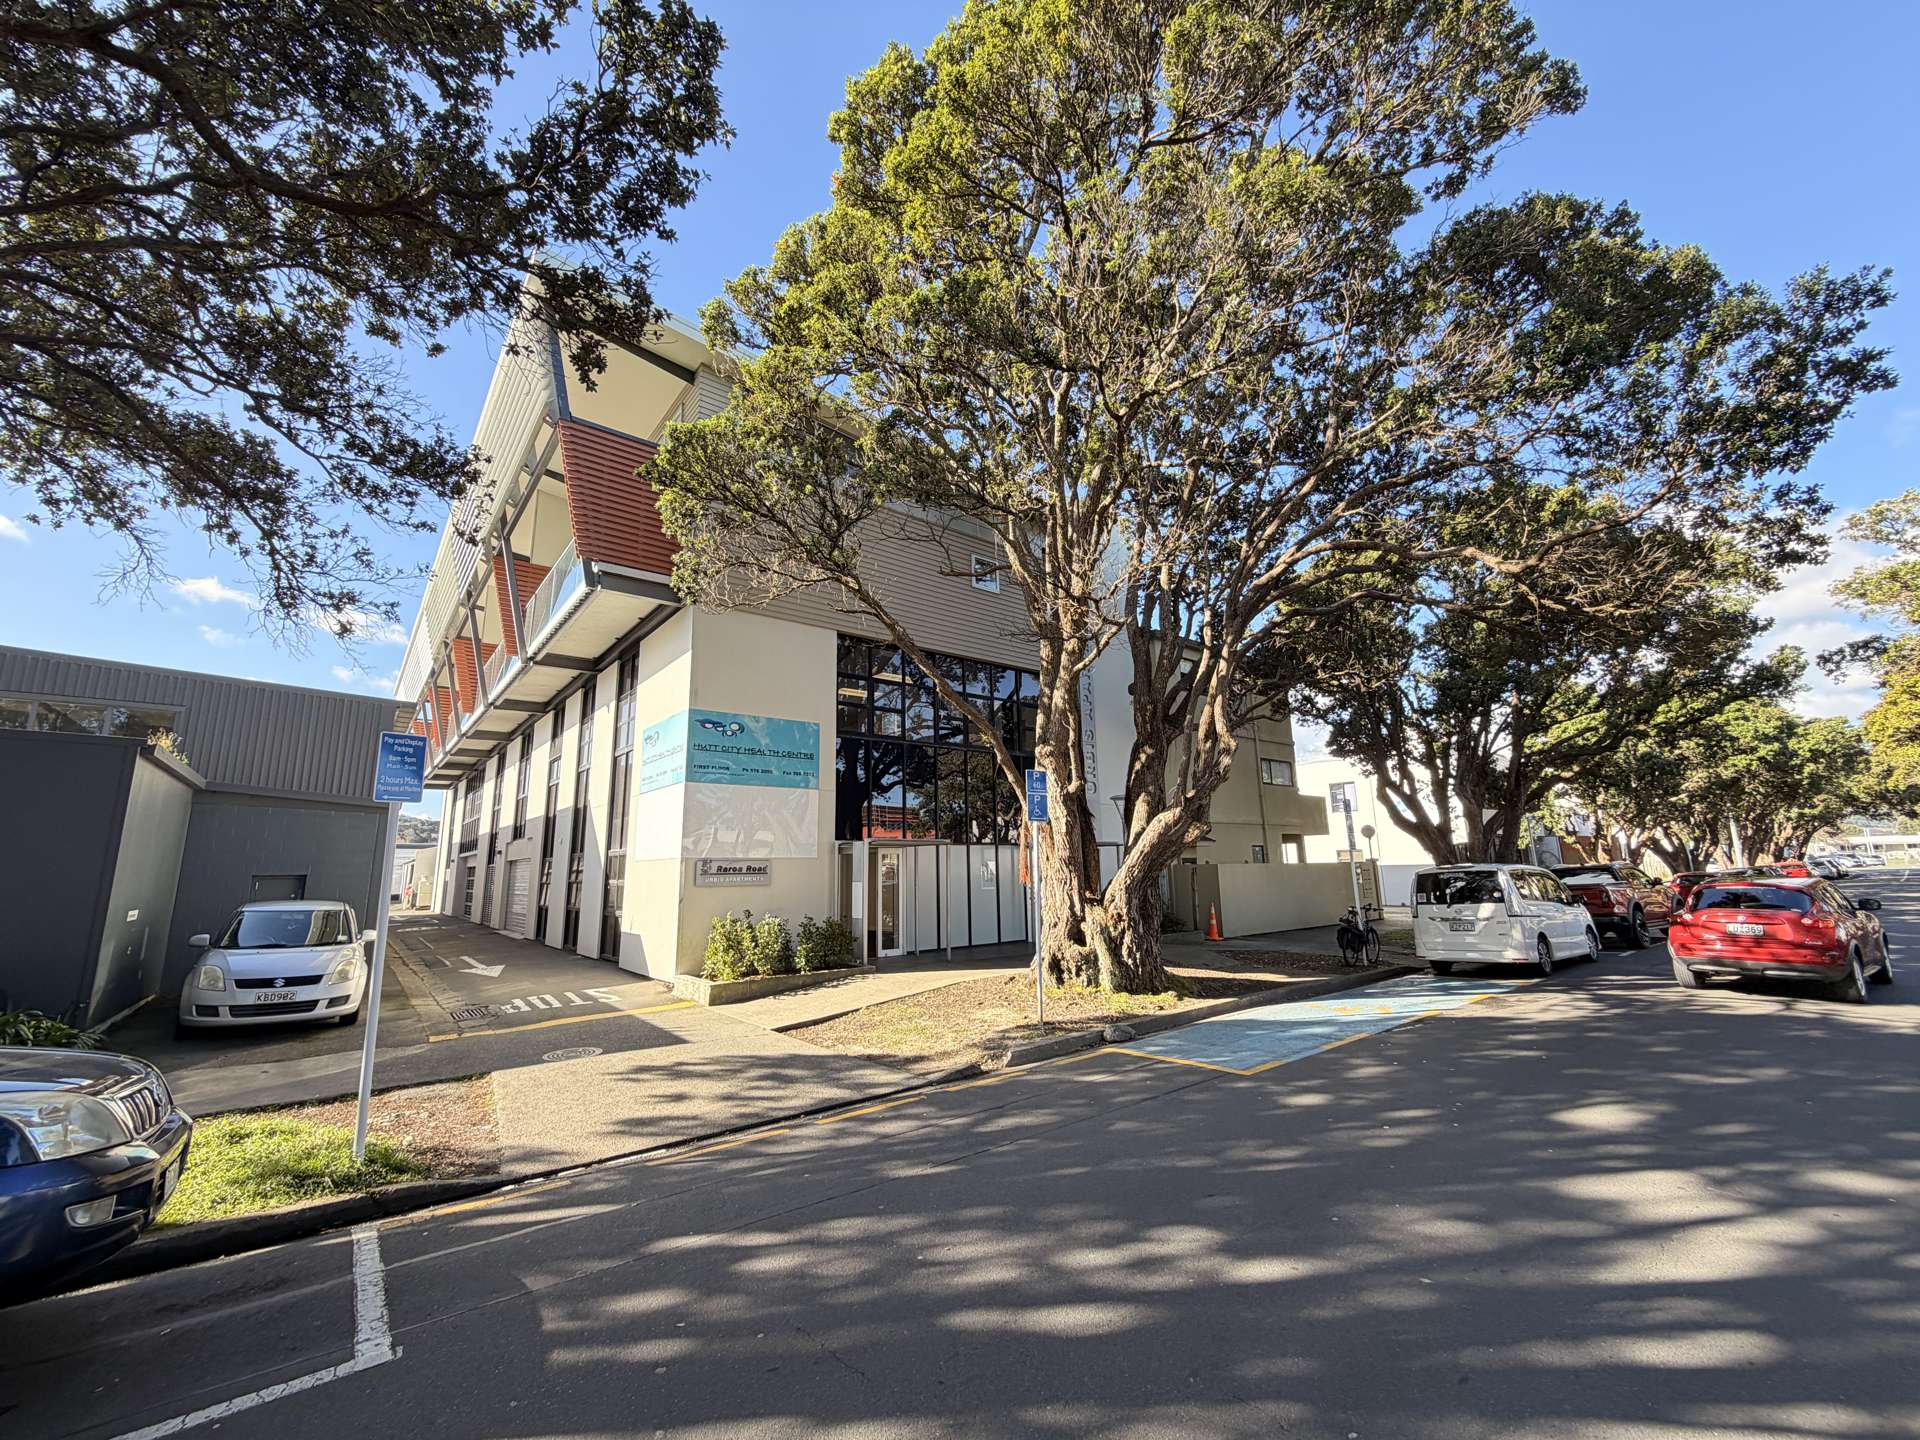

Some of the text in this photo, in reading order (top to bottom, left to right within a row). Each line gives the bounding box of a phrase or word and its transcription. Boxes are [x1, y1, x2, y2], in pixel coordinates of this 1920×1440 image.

[384, 736, 394, 744] Pay
[404, 738, 424, 746] Display
[393, 745, 414, 753] Parking
[693, 743, 815, 760] HUTT CITY HEALTH CENTRE
[385, 776, 403, 784] hours
[1033, 771, 1040, 780] P
[1034, 795, 1041, 804] P
